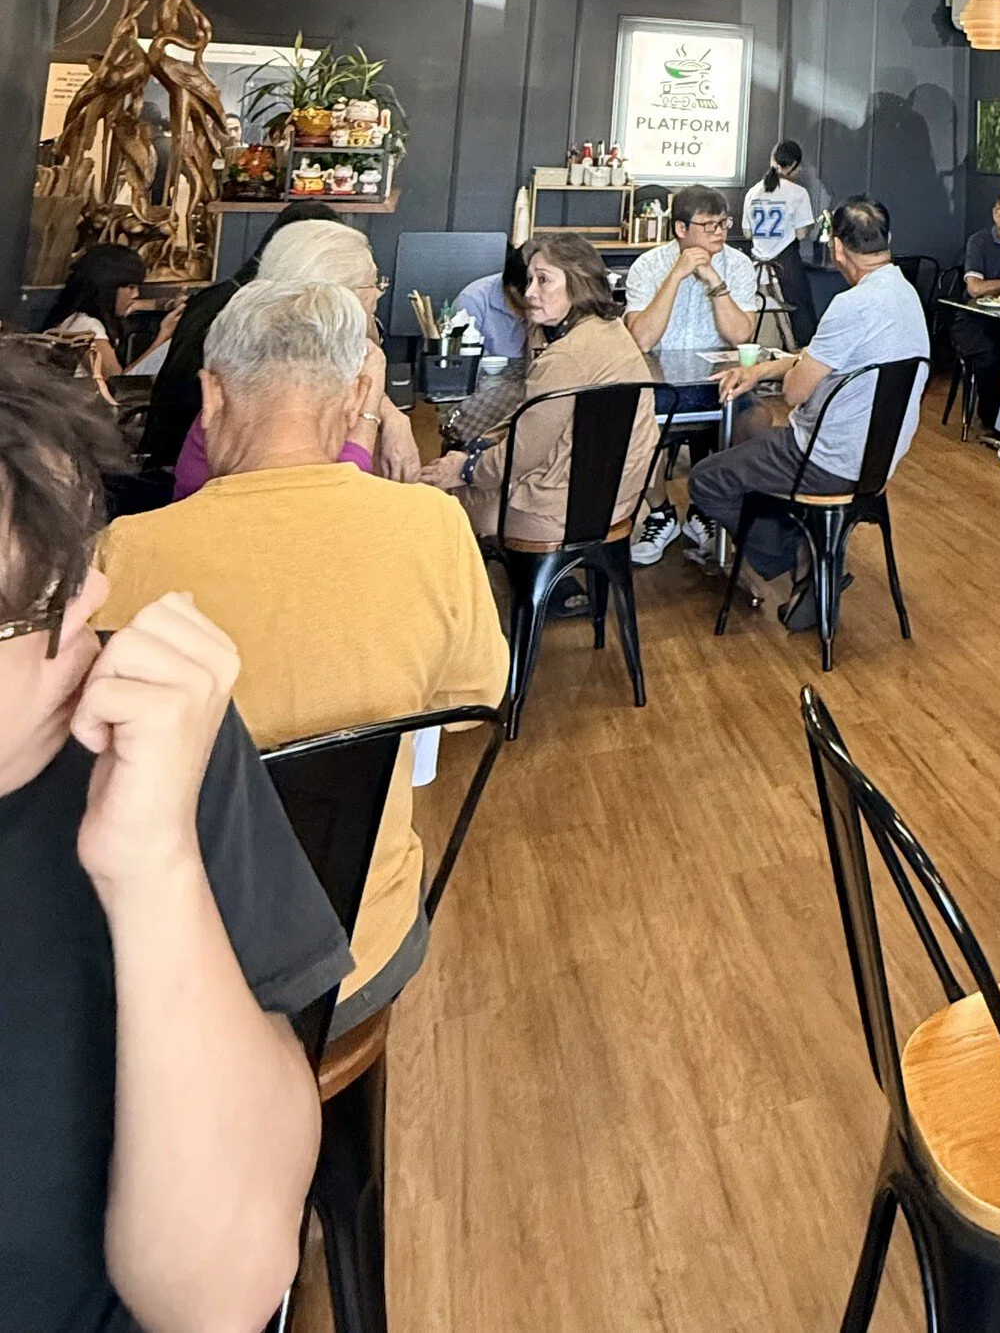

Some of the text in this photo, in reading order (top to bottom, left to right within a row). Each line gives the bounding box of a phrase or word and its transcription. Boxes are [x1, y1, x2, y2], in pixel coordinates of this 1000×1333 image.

[636, 116, 730, 133] PLATFORM
[661, 135, 703, 155] PHỞ
[751, 207, 784, 239] 22
